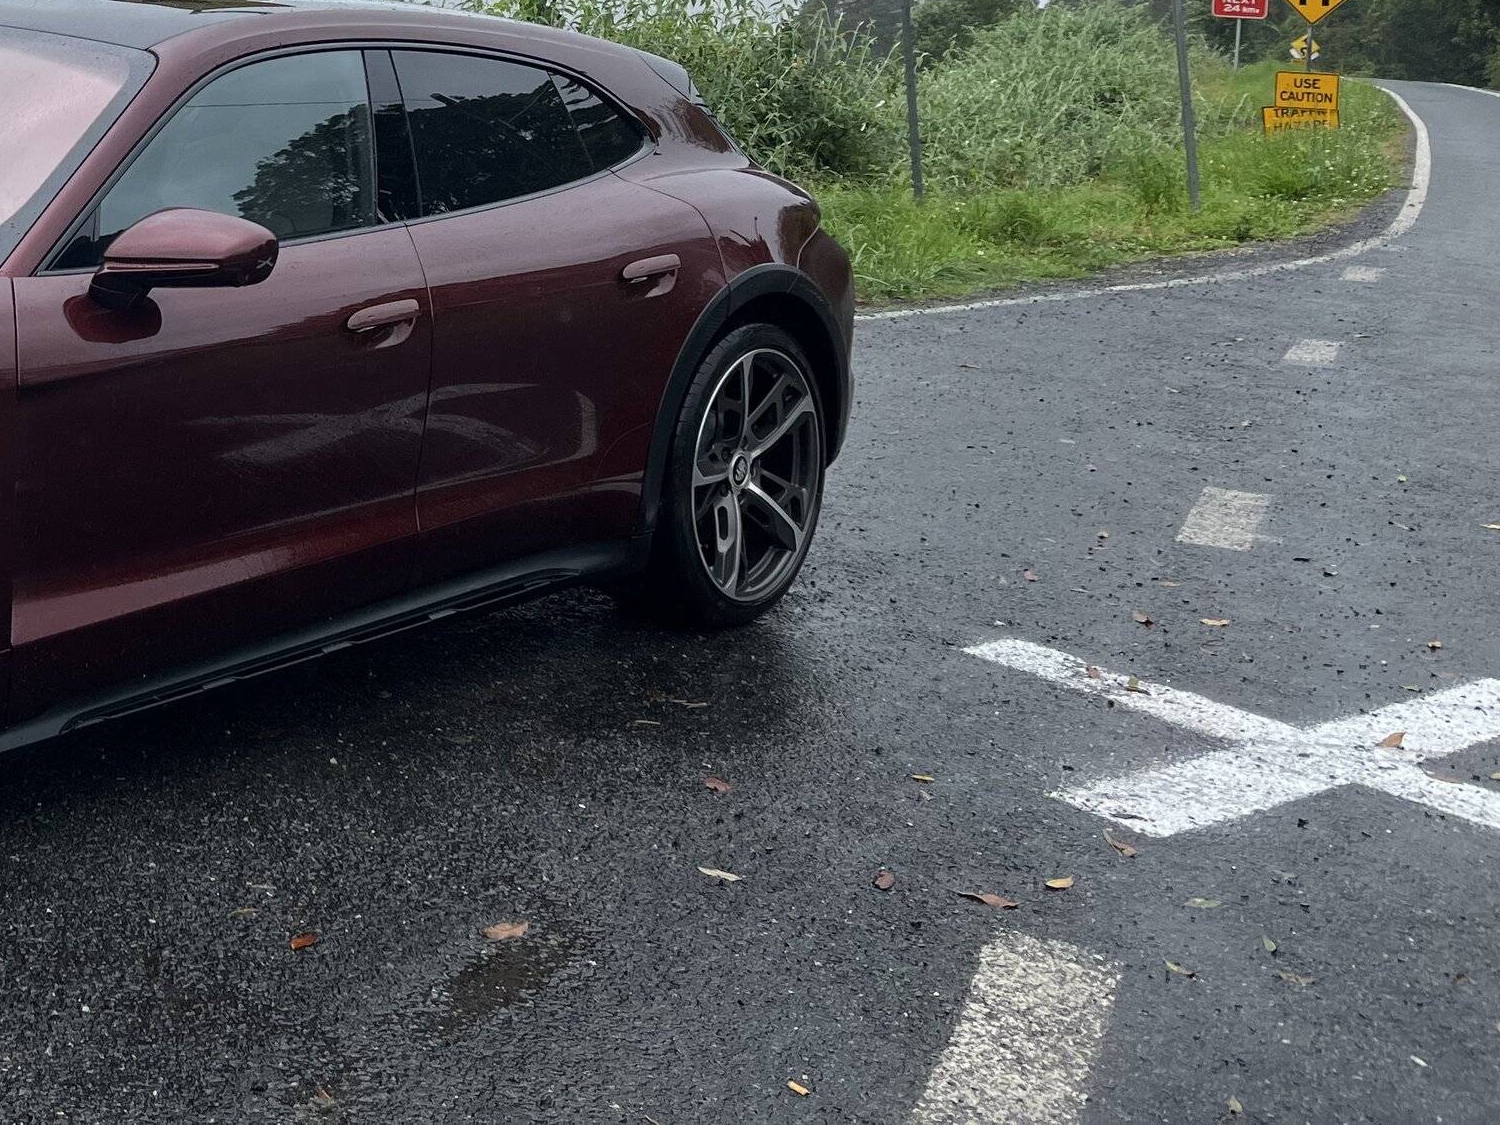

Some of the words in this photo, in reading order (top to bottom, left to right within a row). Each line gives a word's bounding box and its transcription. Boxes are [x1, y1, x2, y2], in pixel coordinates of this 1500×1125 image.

[1223, 4, 1241, 12] 24
[1293, 78, 1320, 89] USE
[1280, 90, 1333, 103] CAUTION
